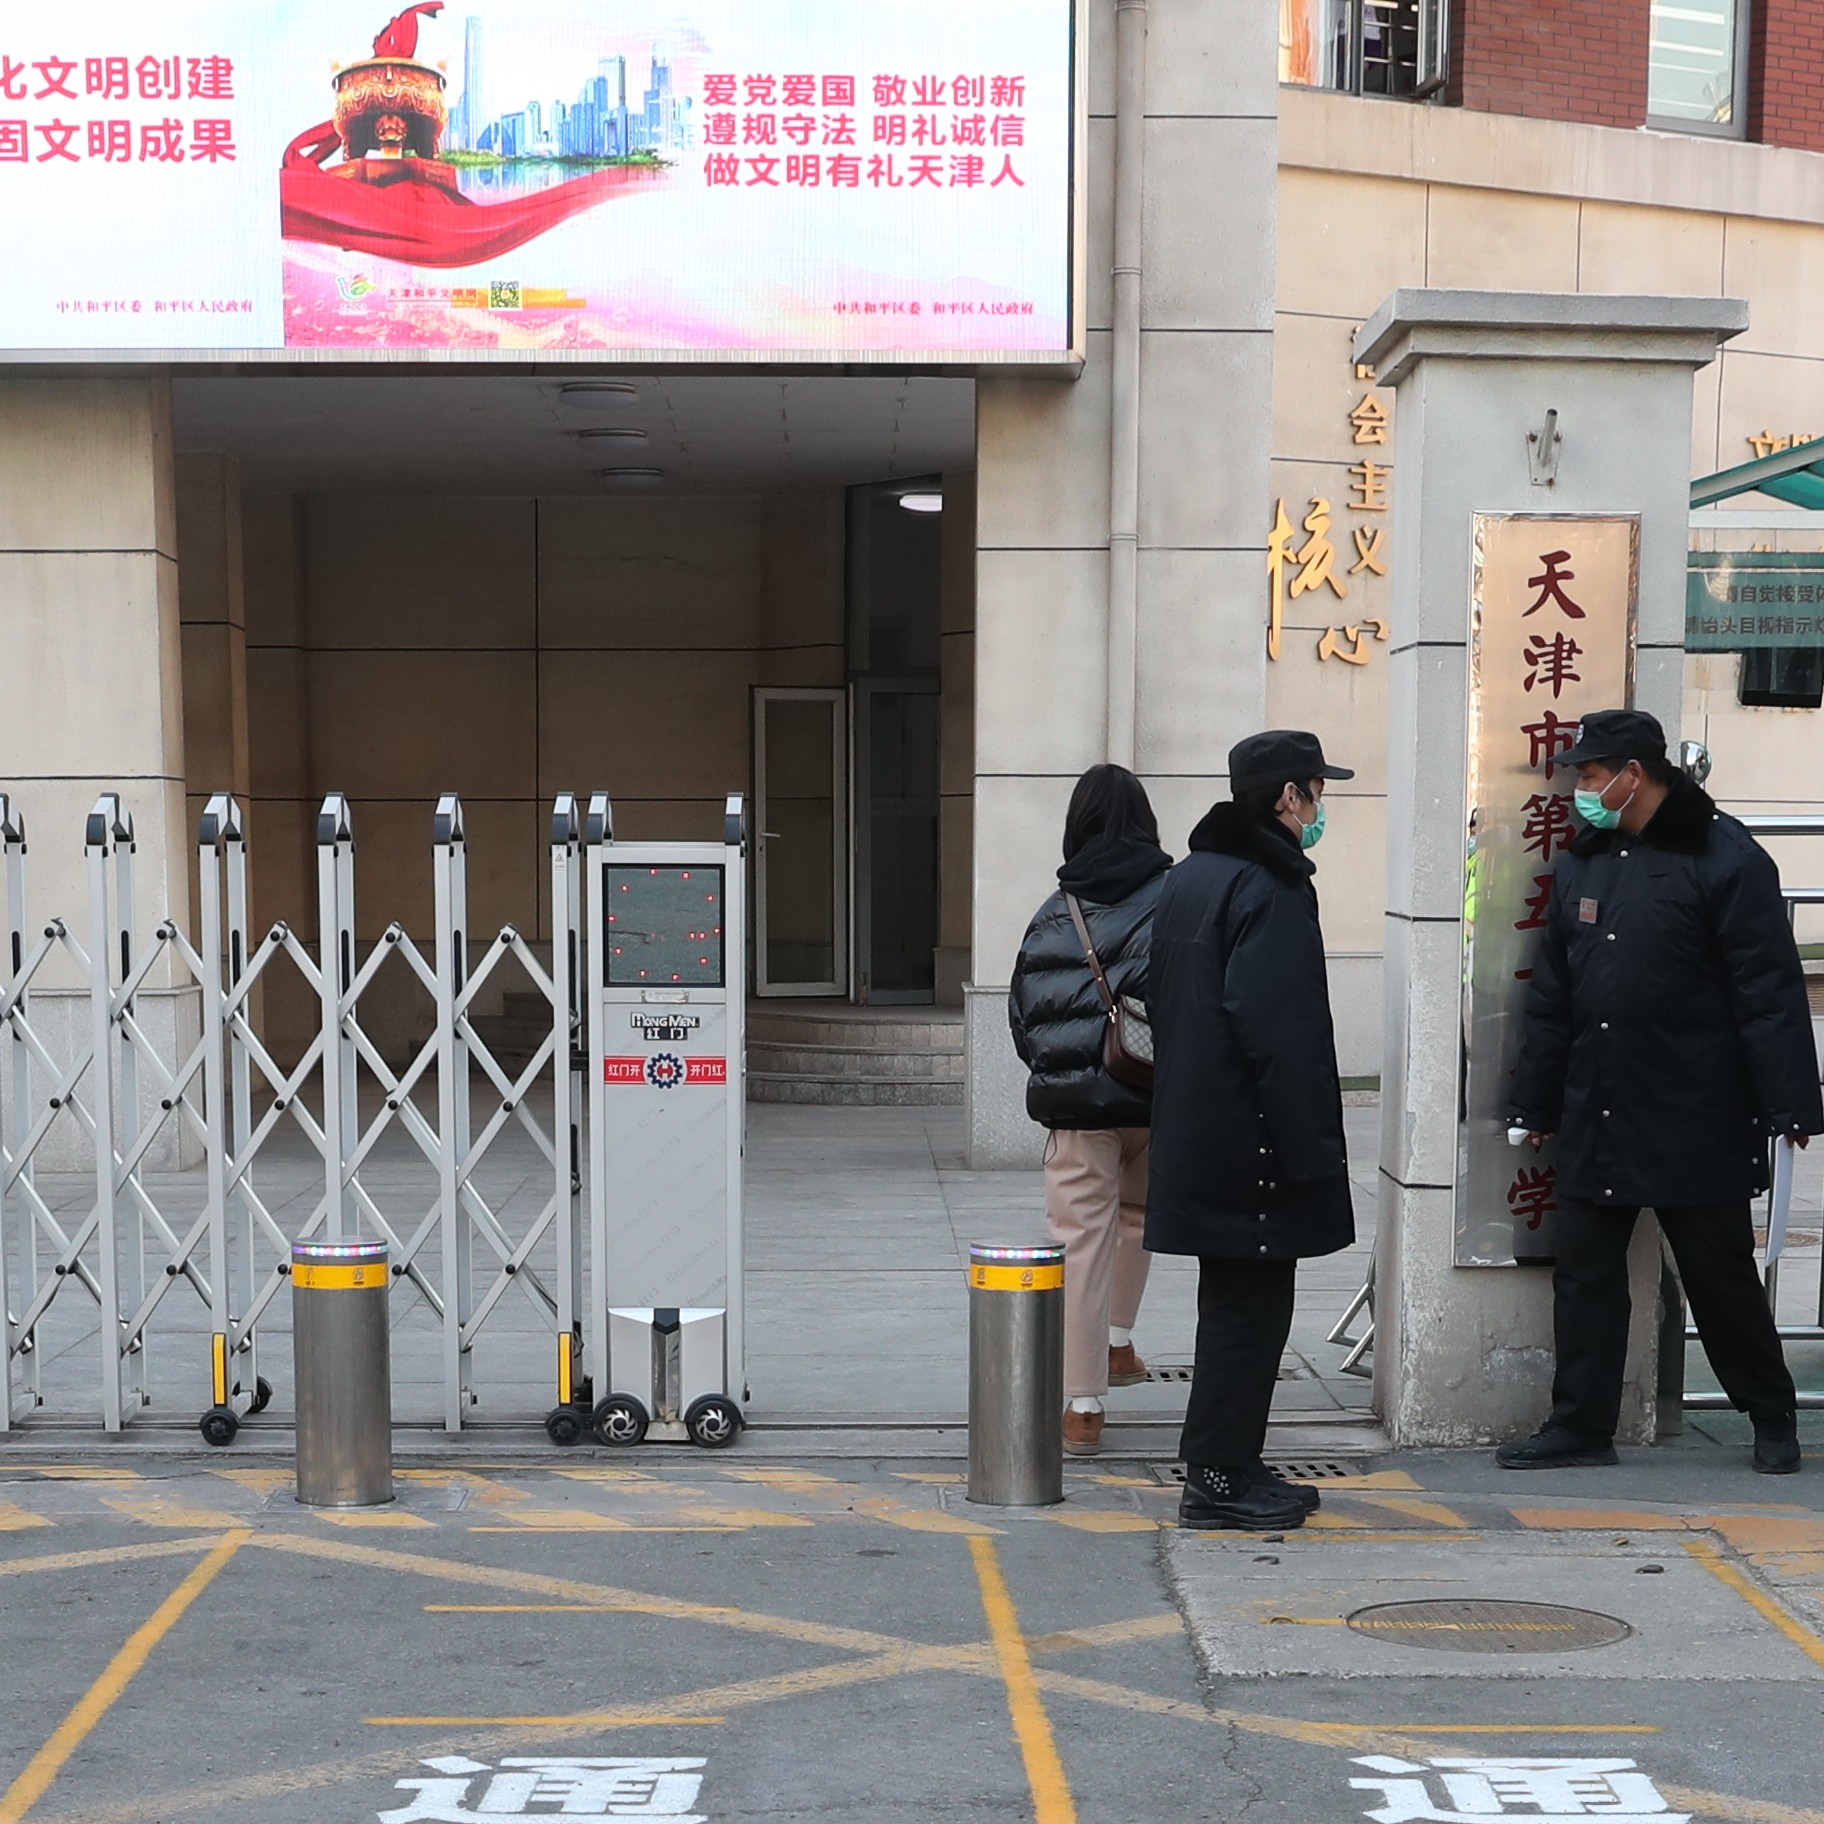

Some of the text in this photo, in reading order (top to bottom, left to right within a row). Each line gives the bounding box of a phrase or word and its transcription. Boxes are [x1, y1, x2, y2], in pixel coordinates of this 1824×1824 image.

[703, 74, 1026, 107] 爱党爱国 敬业创新
[703, 113, 1025, 147] 遵规守法 明礼诚信
[703, 153, 1026, 188] 做文明有礼天津人
[56, 300, 253, 313] 中共和平区委 和平区人民政府
[833, 301, 1034, 315] 中共和平区委 和平区人民政府
[646, 1028, 685, 1040] 红门
[607, 1064, 641, 1077] 红门开
[690, 1064, 724, 1077] 开门红
